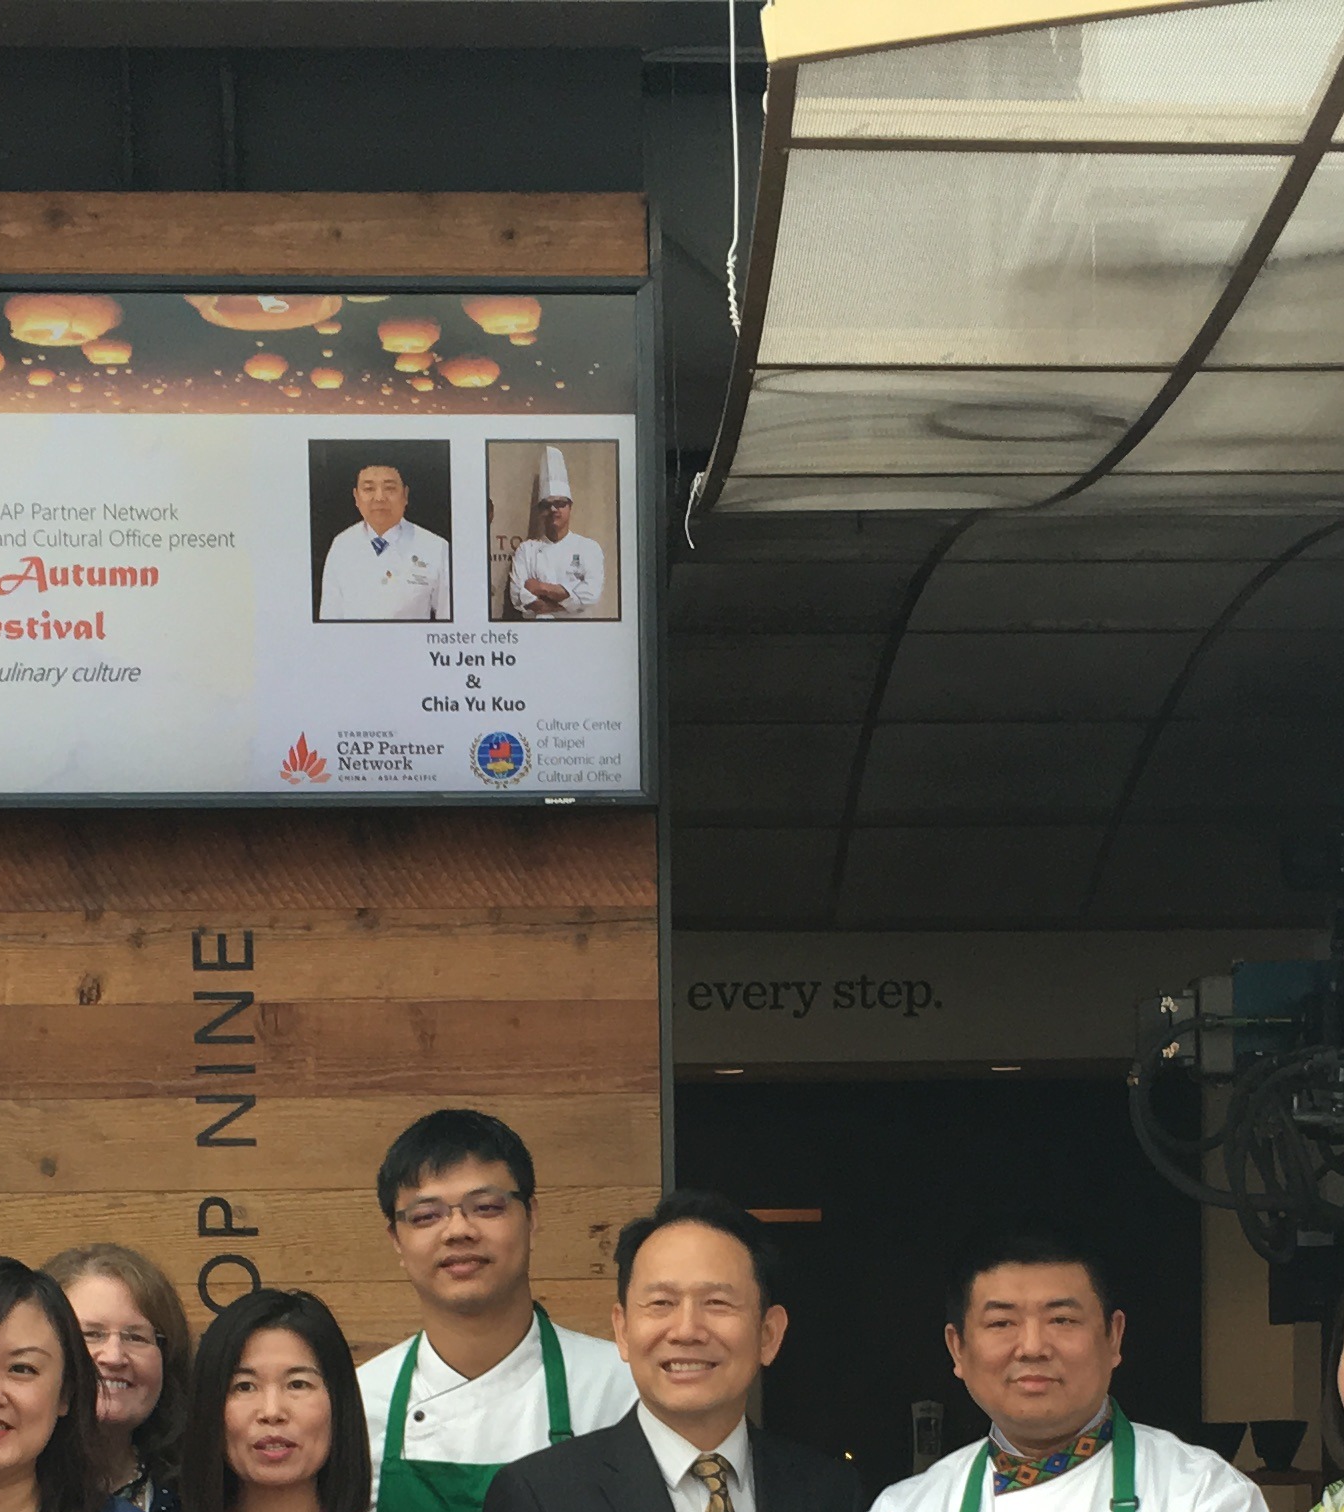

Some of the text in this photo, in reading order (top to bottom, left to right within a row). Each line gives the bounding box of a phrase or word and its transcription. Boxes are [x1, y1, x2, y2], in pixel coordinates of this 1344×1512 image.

[31, 503, 96, 521] Partner
[103, 503, 179, 521] Network
[33, 529, 103, 548] Cultural
[109, 529, 163, 548] Office
[169, 530, 236, 552] present
[426, 629, 519, 645] master chefs
[429, 651, 517, 667] Yu Jen Ho
[72, 663, 142, 684] culture
[465, 673, 482, 689] &
[421, 696, 526, 713] Chia Yu Kuo
[536, 718, 623, 732] Culture Center
[337, 731, 394, 739] STARBUCKS
[536, 735, 585, 751] of Taipei
[337, 740, 445, 756] CAP Partner
[338, 755, 414, 771] Network
[537, 753, 622, 766] Economic and
[537, 770, 622, 783] Cultural Office
[687, 981, 822, 1019] every
[833, 974, 943, 1018] step.
[191, 929, 262, 1317] OP NINE
